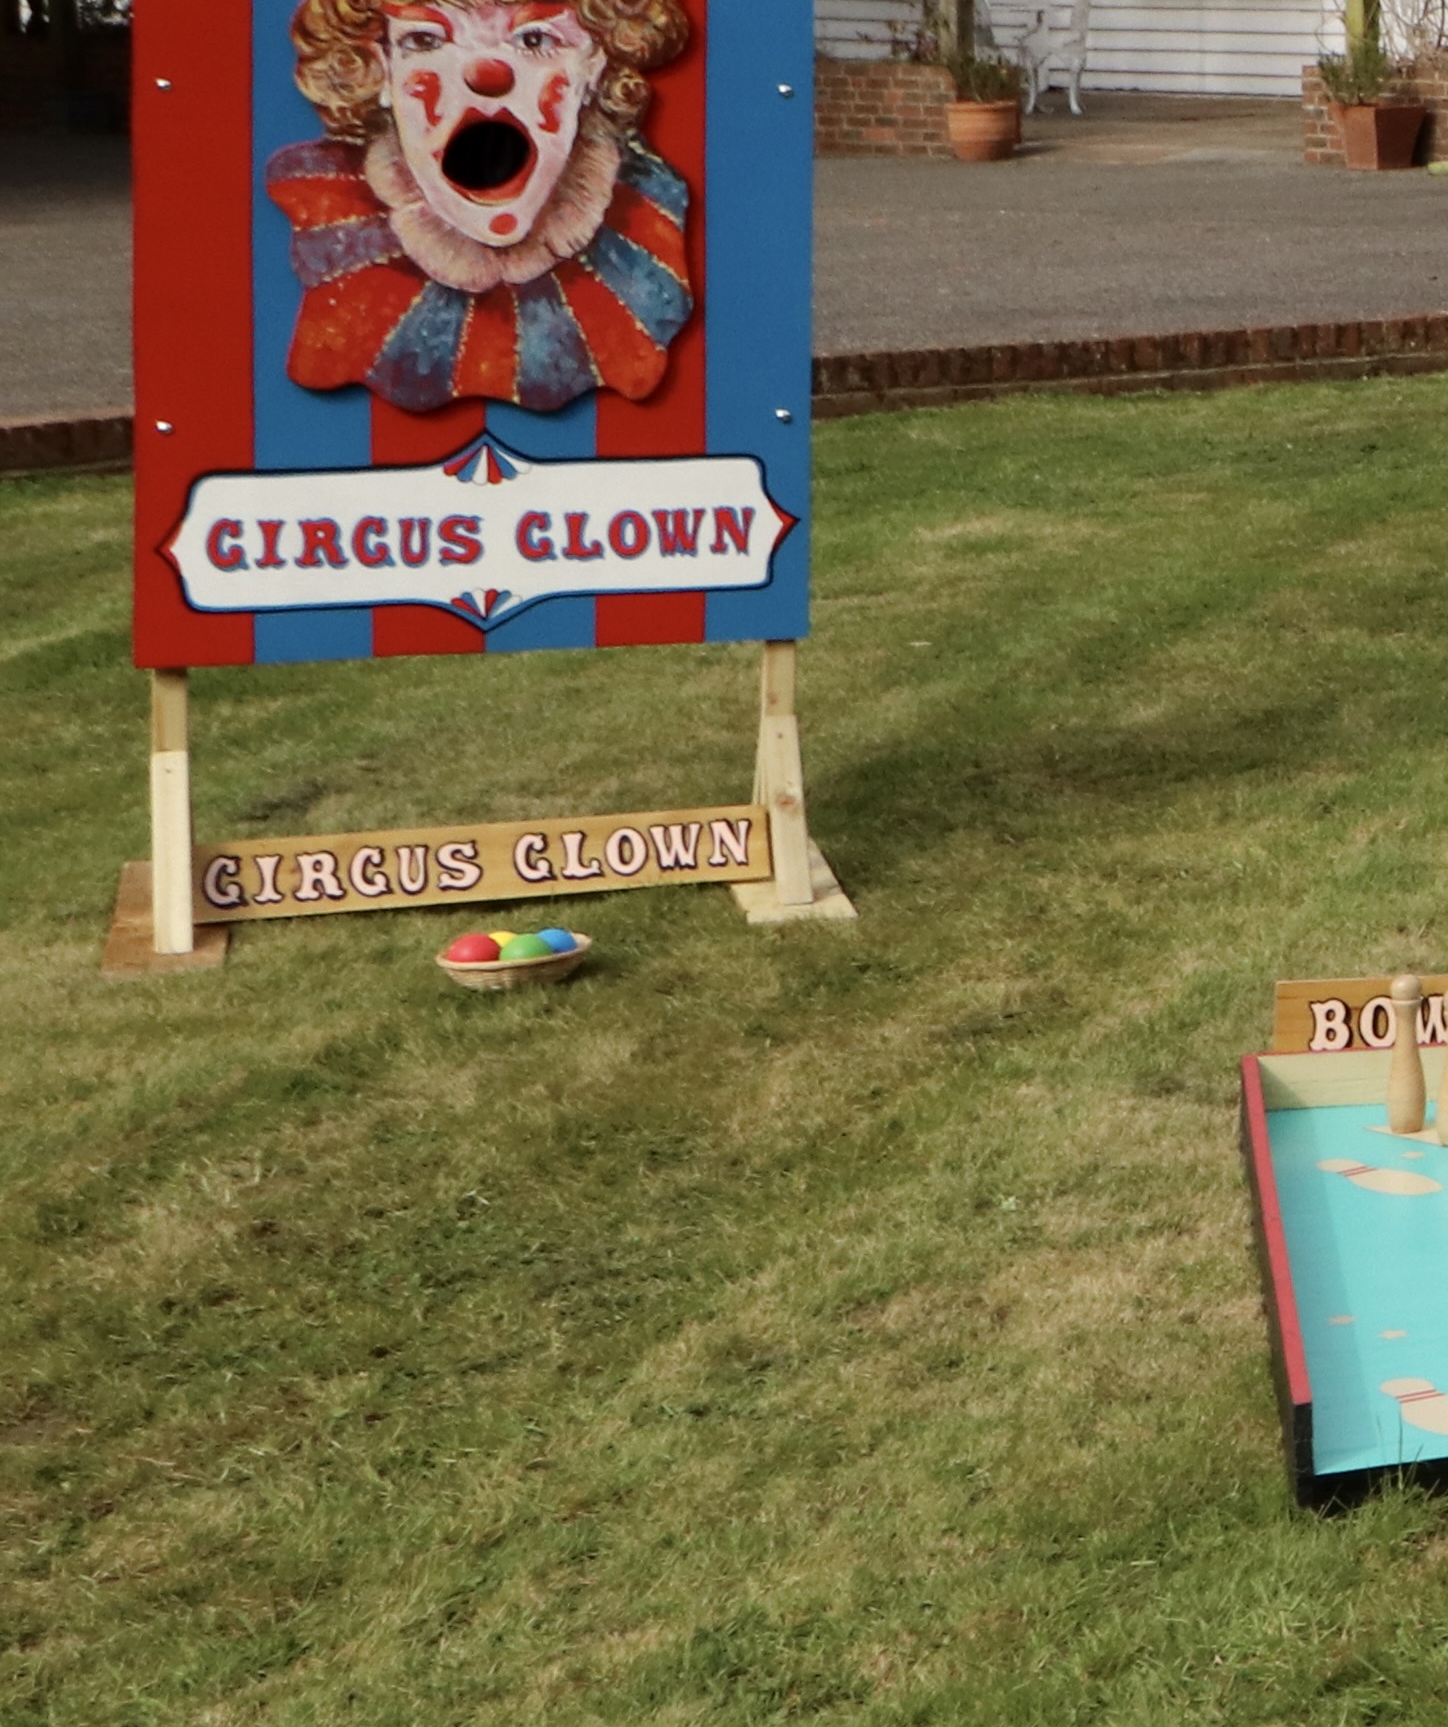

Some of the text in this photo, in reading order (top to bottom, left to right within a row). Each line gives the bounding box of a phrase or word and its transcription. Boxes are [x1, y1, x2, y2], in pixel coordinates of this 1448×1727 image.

[205, 505, 756, 571] CIRCUS CLOWN
[204, 817, 753, 910] CIRCUS CLOWN
